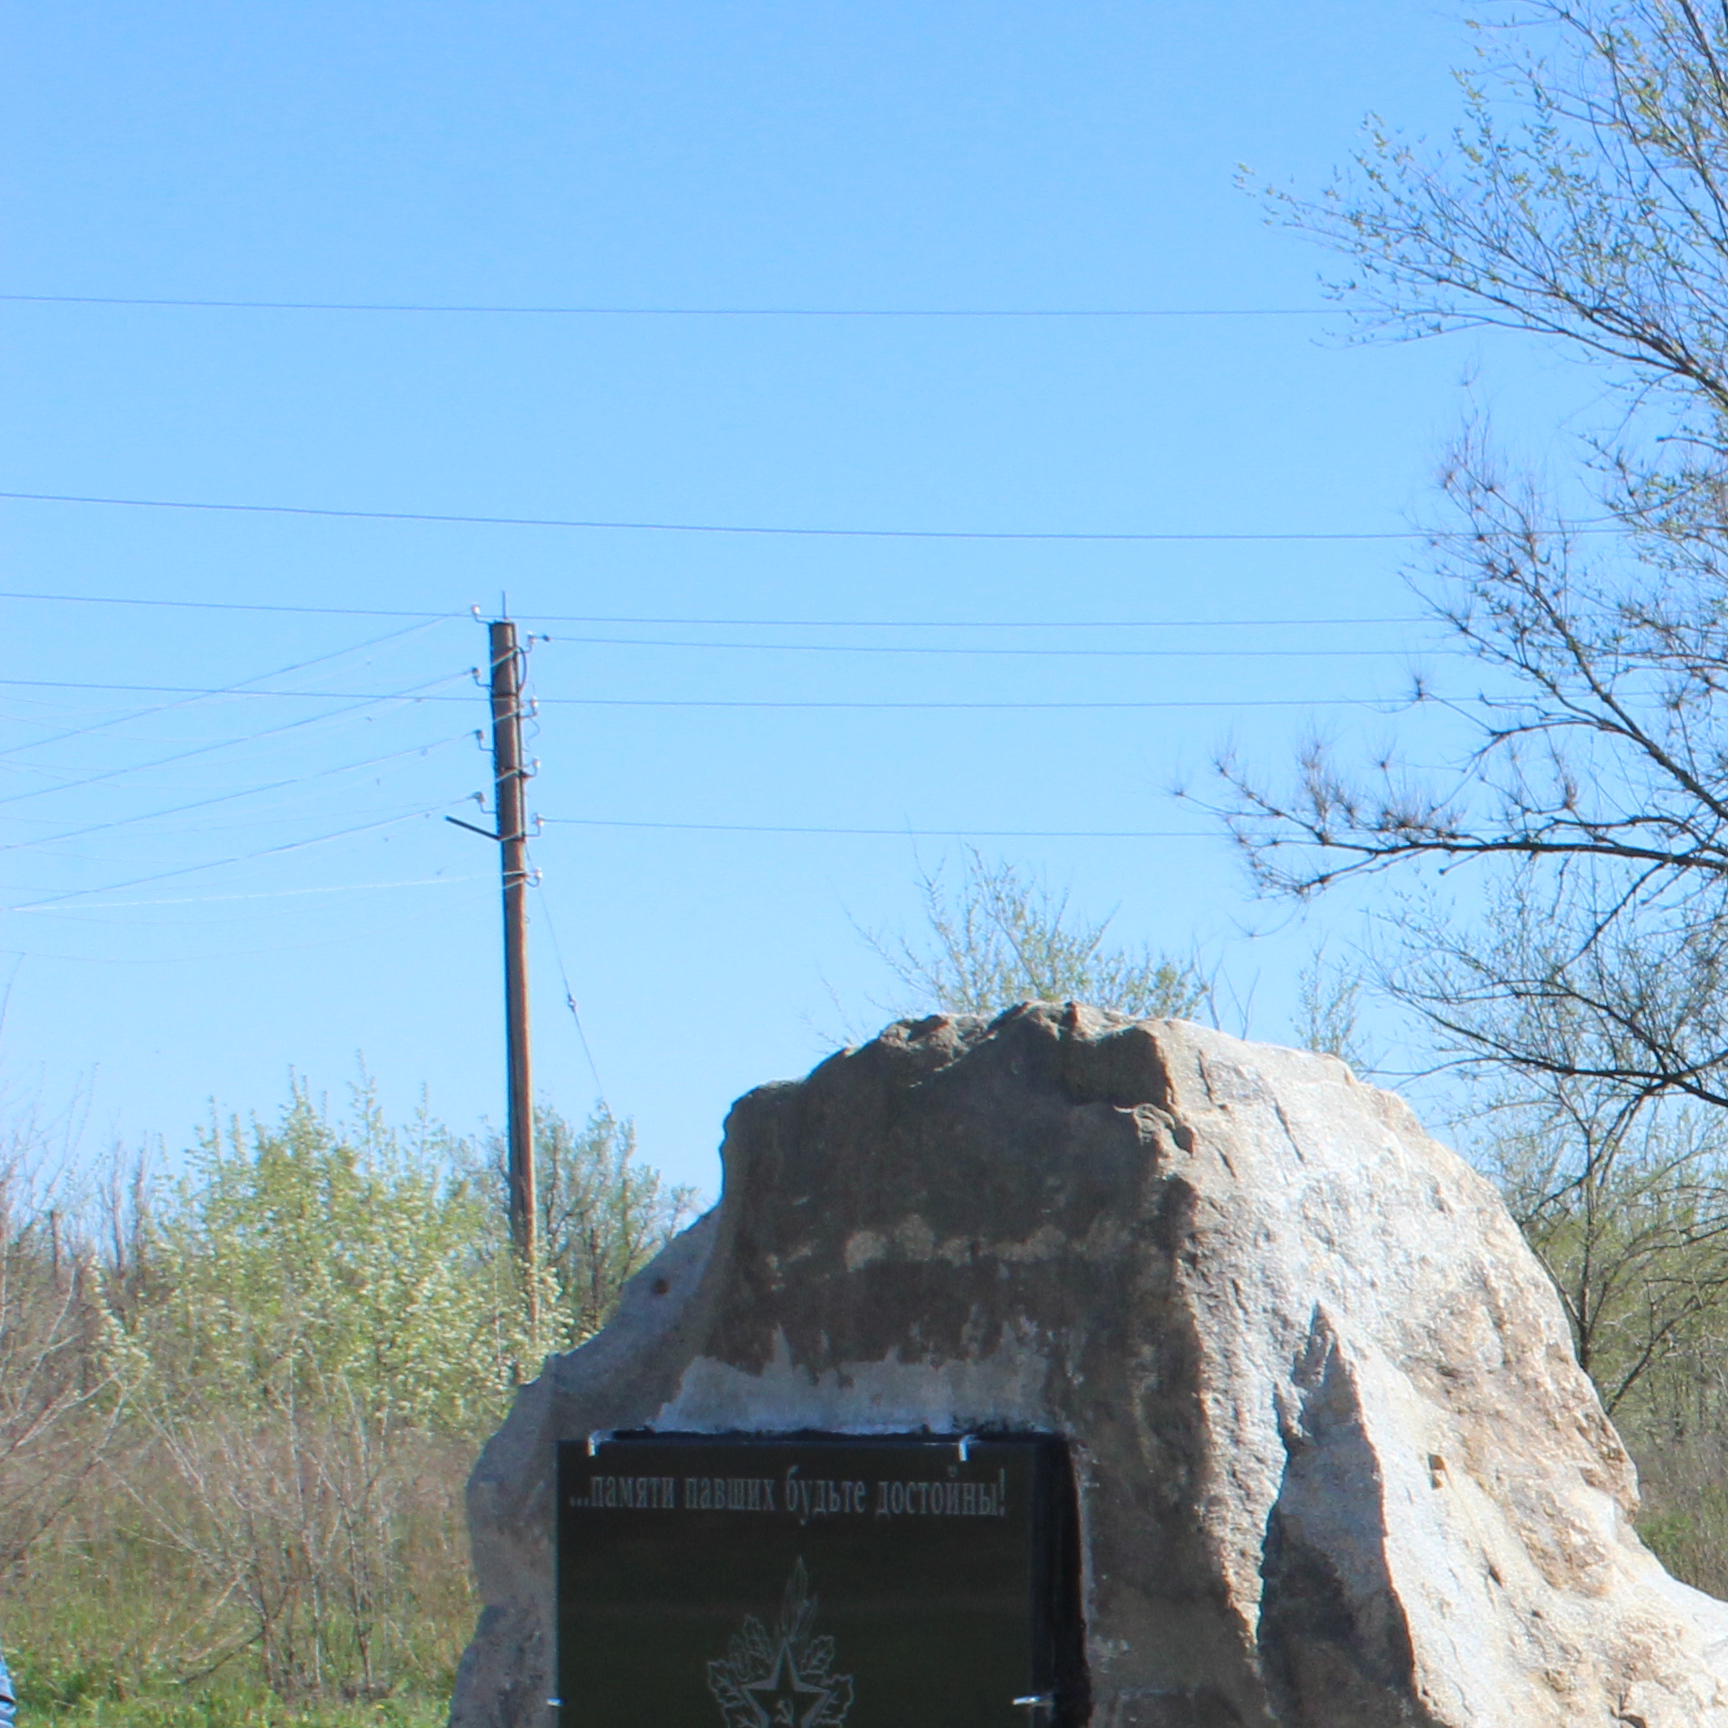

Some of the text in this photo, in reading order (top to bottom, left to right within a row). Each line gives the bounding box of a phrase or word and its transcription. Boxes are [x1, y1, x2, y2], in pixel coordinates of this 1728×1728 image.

[570, 1466, 1006, 1525] ...памяти павших будьте достойны!
